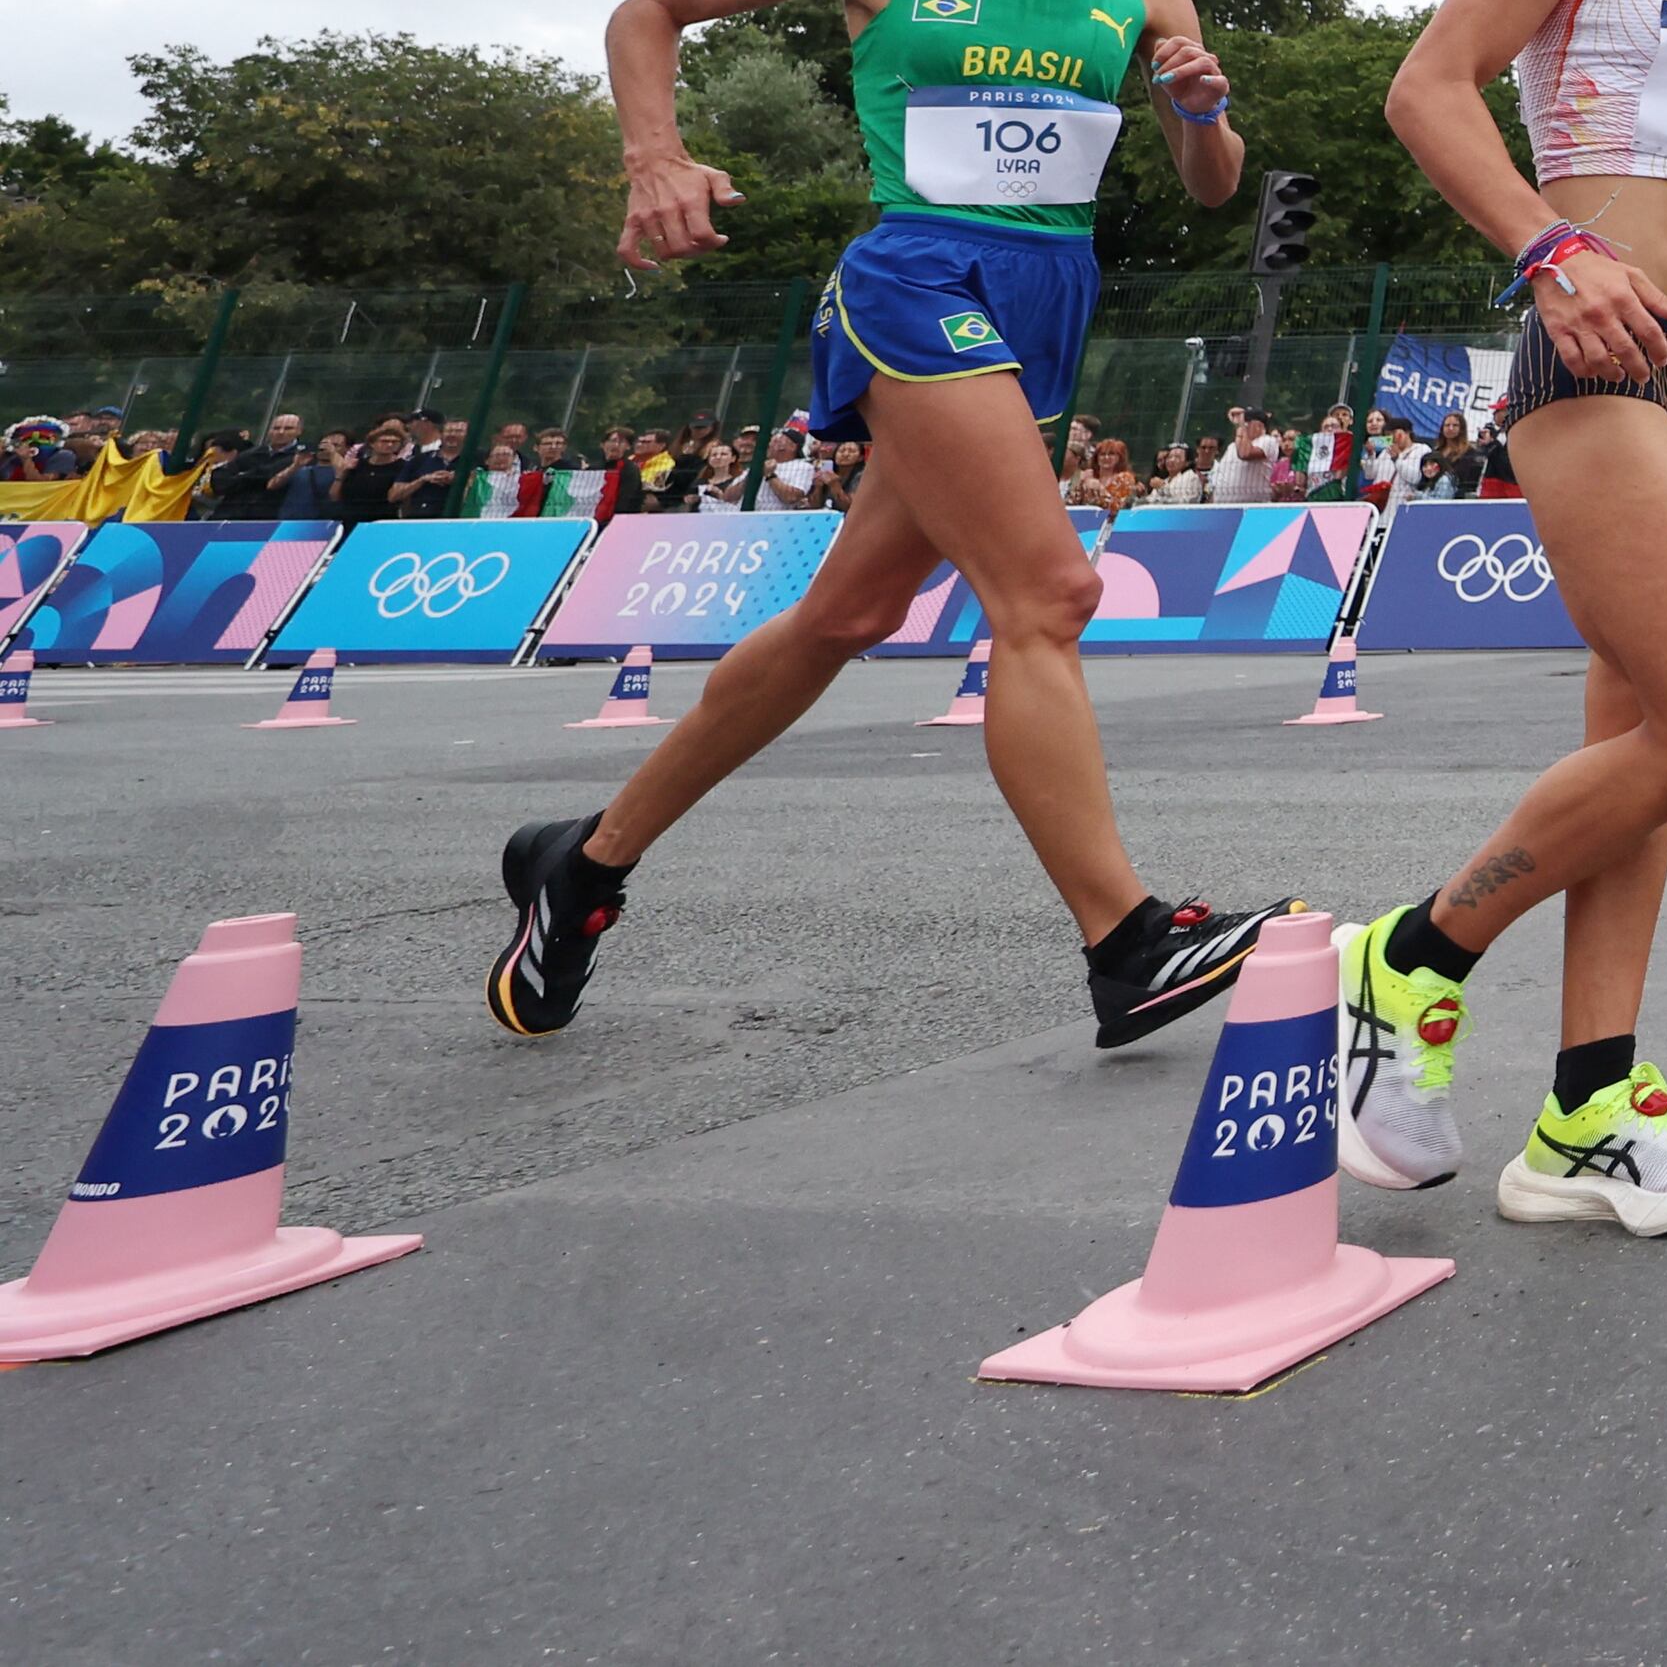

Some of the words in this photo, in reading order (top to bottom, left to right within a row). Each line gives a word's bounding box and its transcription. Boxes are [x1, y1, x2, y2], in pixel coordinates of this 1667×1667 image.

[963, 46, 1084, 88] BRASIL
[970, 91, 1025, 103] PARIS
[1031, 93, 1075, 106] 2024
[976, 119, 1062, 154] 106
[997, 158, 1041, 174] LYRA
[1380, 363, 1494, 412] SARRE
[639, 540, 770, 575] PARIS
[616, 582, 747, 617] 2024
[1219, 1053, 1338, 1112] PARIS
[1212, 1098, 1337, 1158] 2024
